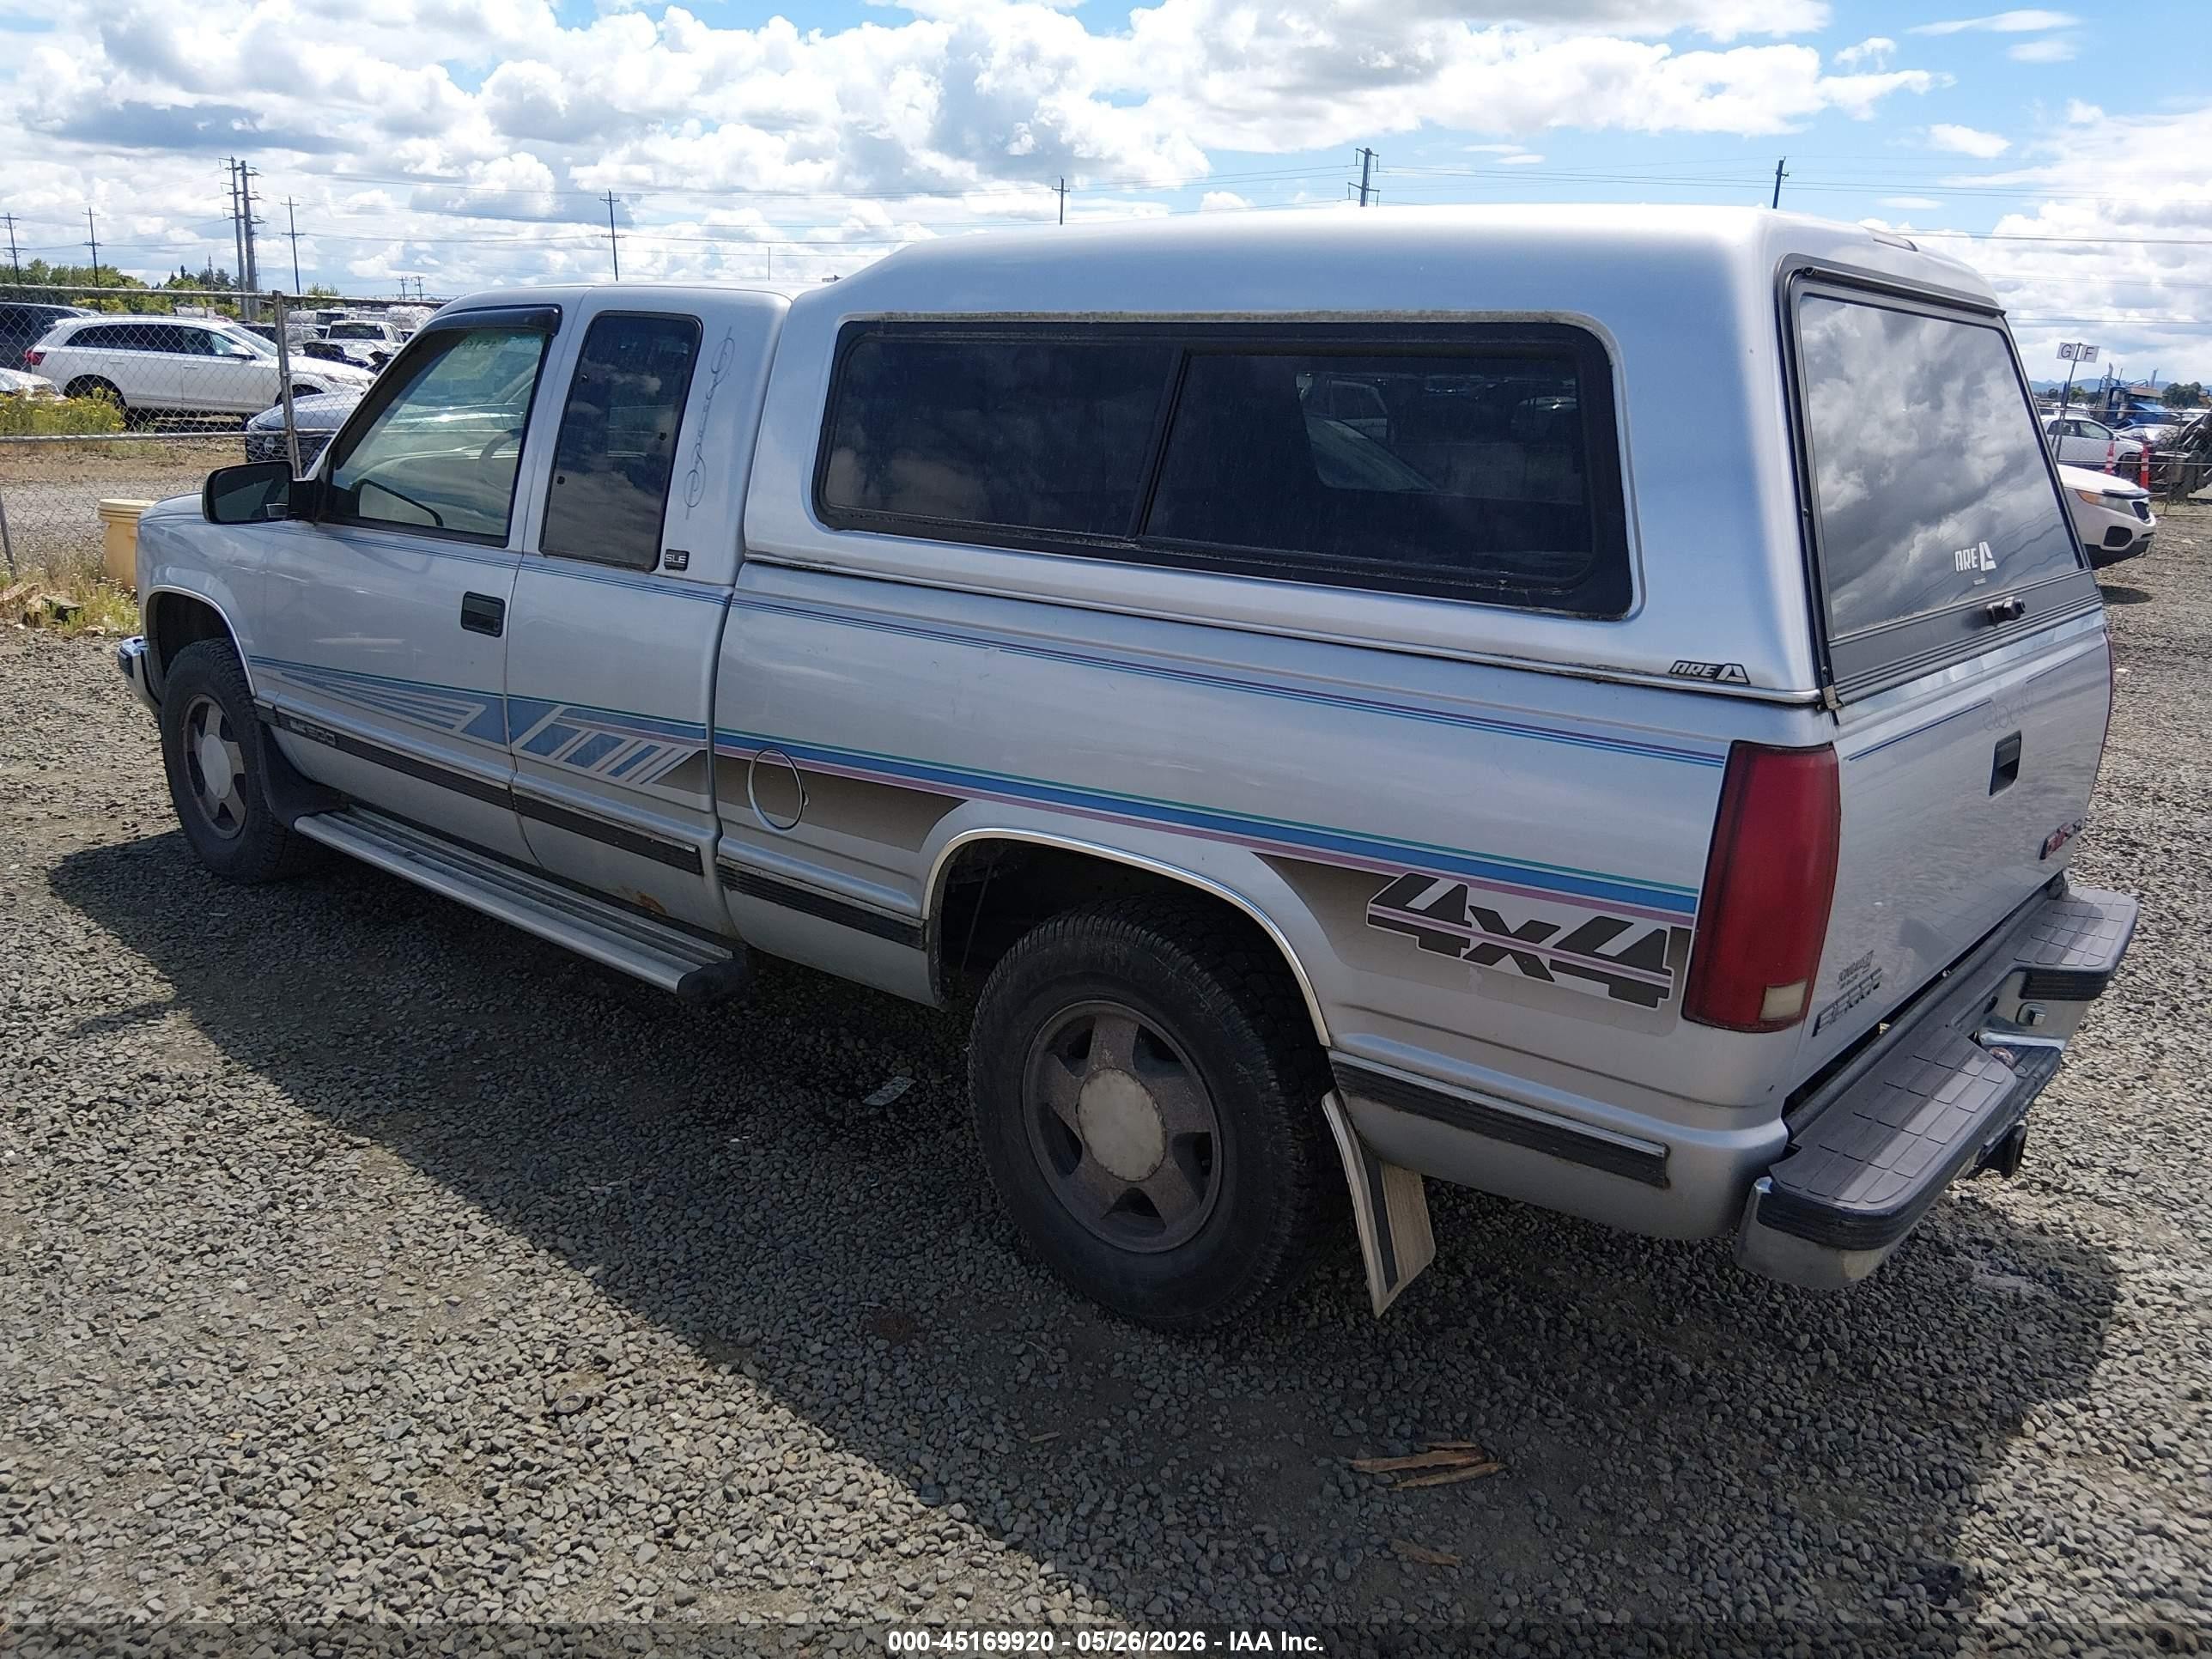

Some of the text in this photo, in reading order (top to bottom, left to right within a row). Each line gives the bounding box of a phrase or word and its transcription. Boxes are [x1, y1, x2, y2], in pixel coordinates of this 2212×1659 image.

[2061, 344, 2072, 358] G
[2084, 347, 2095, 360] F
[665, 554, 687, 564] SLE
